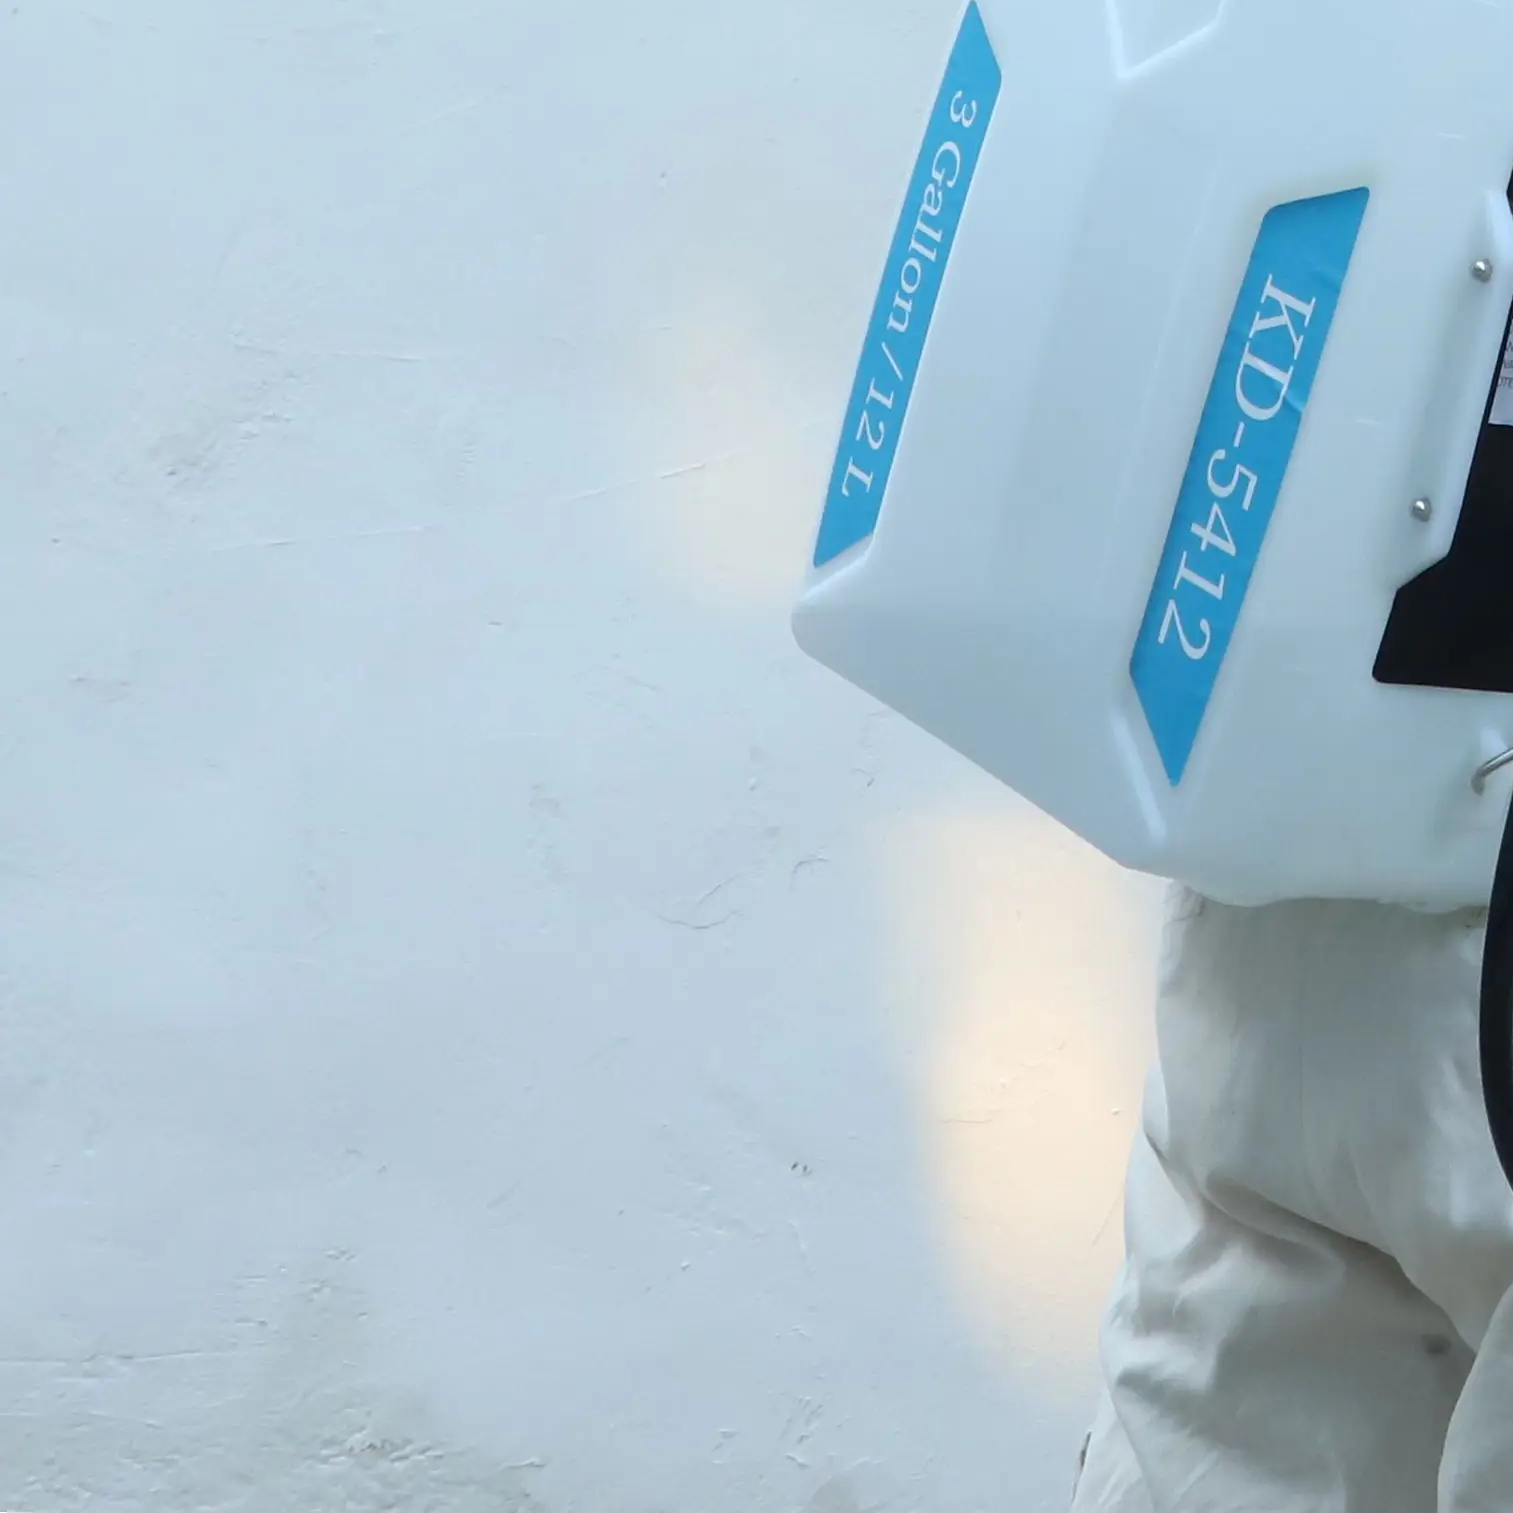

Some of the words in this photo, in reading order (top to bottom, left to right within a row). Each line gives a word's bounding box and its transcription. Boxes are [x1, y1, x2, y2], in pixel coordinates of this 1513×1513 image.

[950, 90, 976, 128] 3
[886, 140, 961, 333] Gallon
[855, 377, 895, 450] 12
[841, 456, 874, 497] L
[1157, 273, 1316, 660] KD-5412
